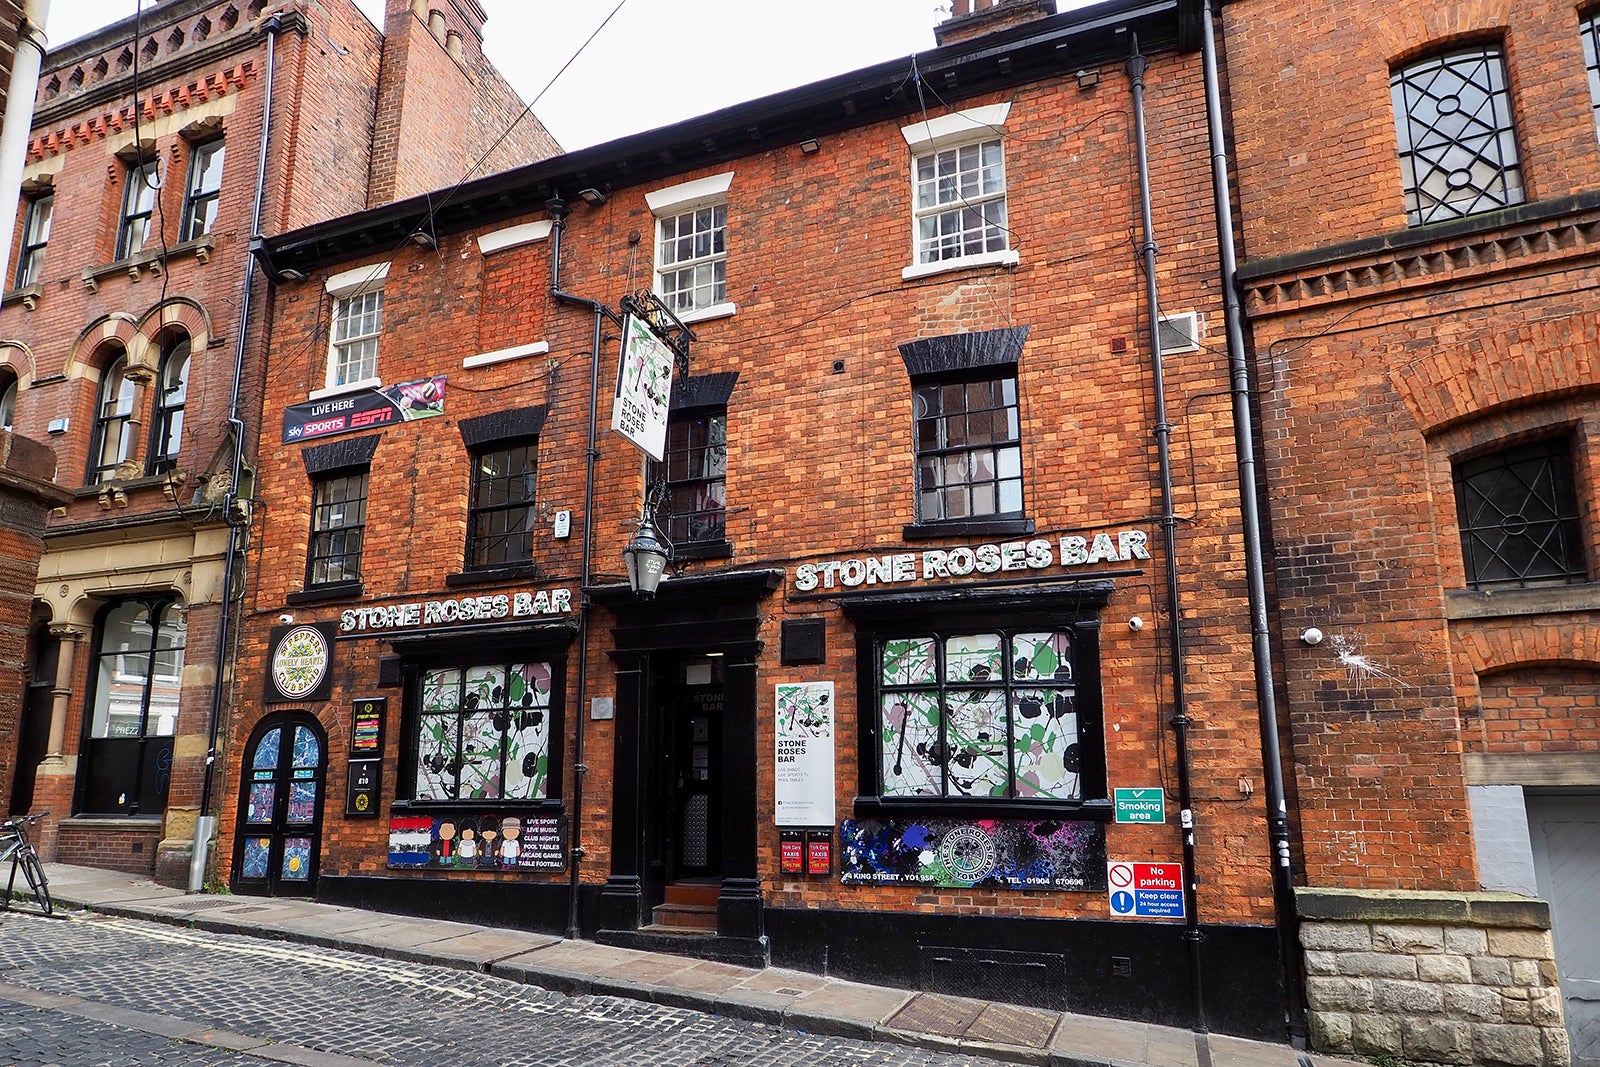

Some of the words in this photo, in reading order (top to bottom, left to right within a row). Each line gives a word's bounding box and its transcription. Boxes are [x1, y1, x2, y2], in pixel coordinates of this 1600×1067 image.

[311, 403, 330, 416] LIVE
[333, 399, 355, 413] HERE
[622, 397, 647, 423] STONE
[351, 407, 393, 428] ESPN
[621, 408, 645, 433] ROSES
[288, 425, 303, 437] sky
[305, 418, 344, 434] SPORTS
[620, 420, 635, 438] BAR
[795, 553, 916, 591] STONE
[923, 539, 1052, 579] ROSES
[1059, 530, 1151, 567] BAR
[339, 602, 421, 632] STONE
[424, 594, 509, 625] ROSES
[513, 588, 572, 617] BAR
[276, 658, 299, 668] LONELY
[301, 656, 325, 666] HEARTS
[279, 672, 296, 691] CLUB
[298, 668, 320, 691] BAND
[702, 702, 724, 711] BAR
[1119, 802, 1161, 812] Smoking
[1129, 812, 1151, 820] area
[944, 829, 966, 850] STONE
[969, 829, 991, 852] ROSES
[943, 853, 952, 871] THE
[957, 872, 980, 880] YORK
[1150, 867, 1164, 876] No
[1140, 878, 1176, 888] parking
[1140, 892, 1158, 900] Keep
